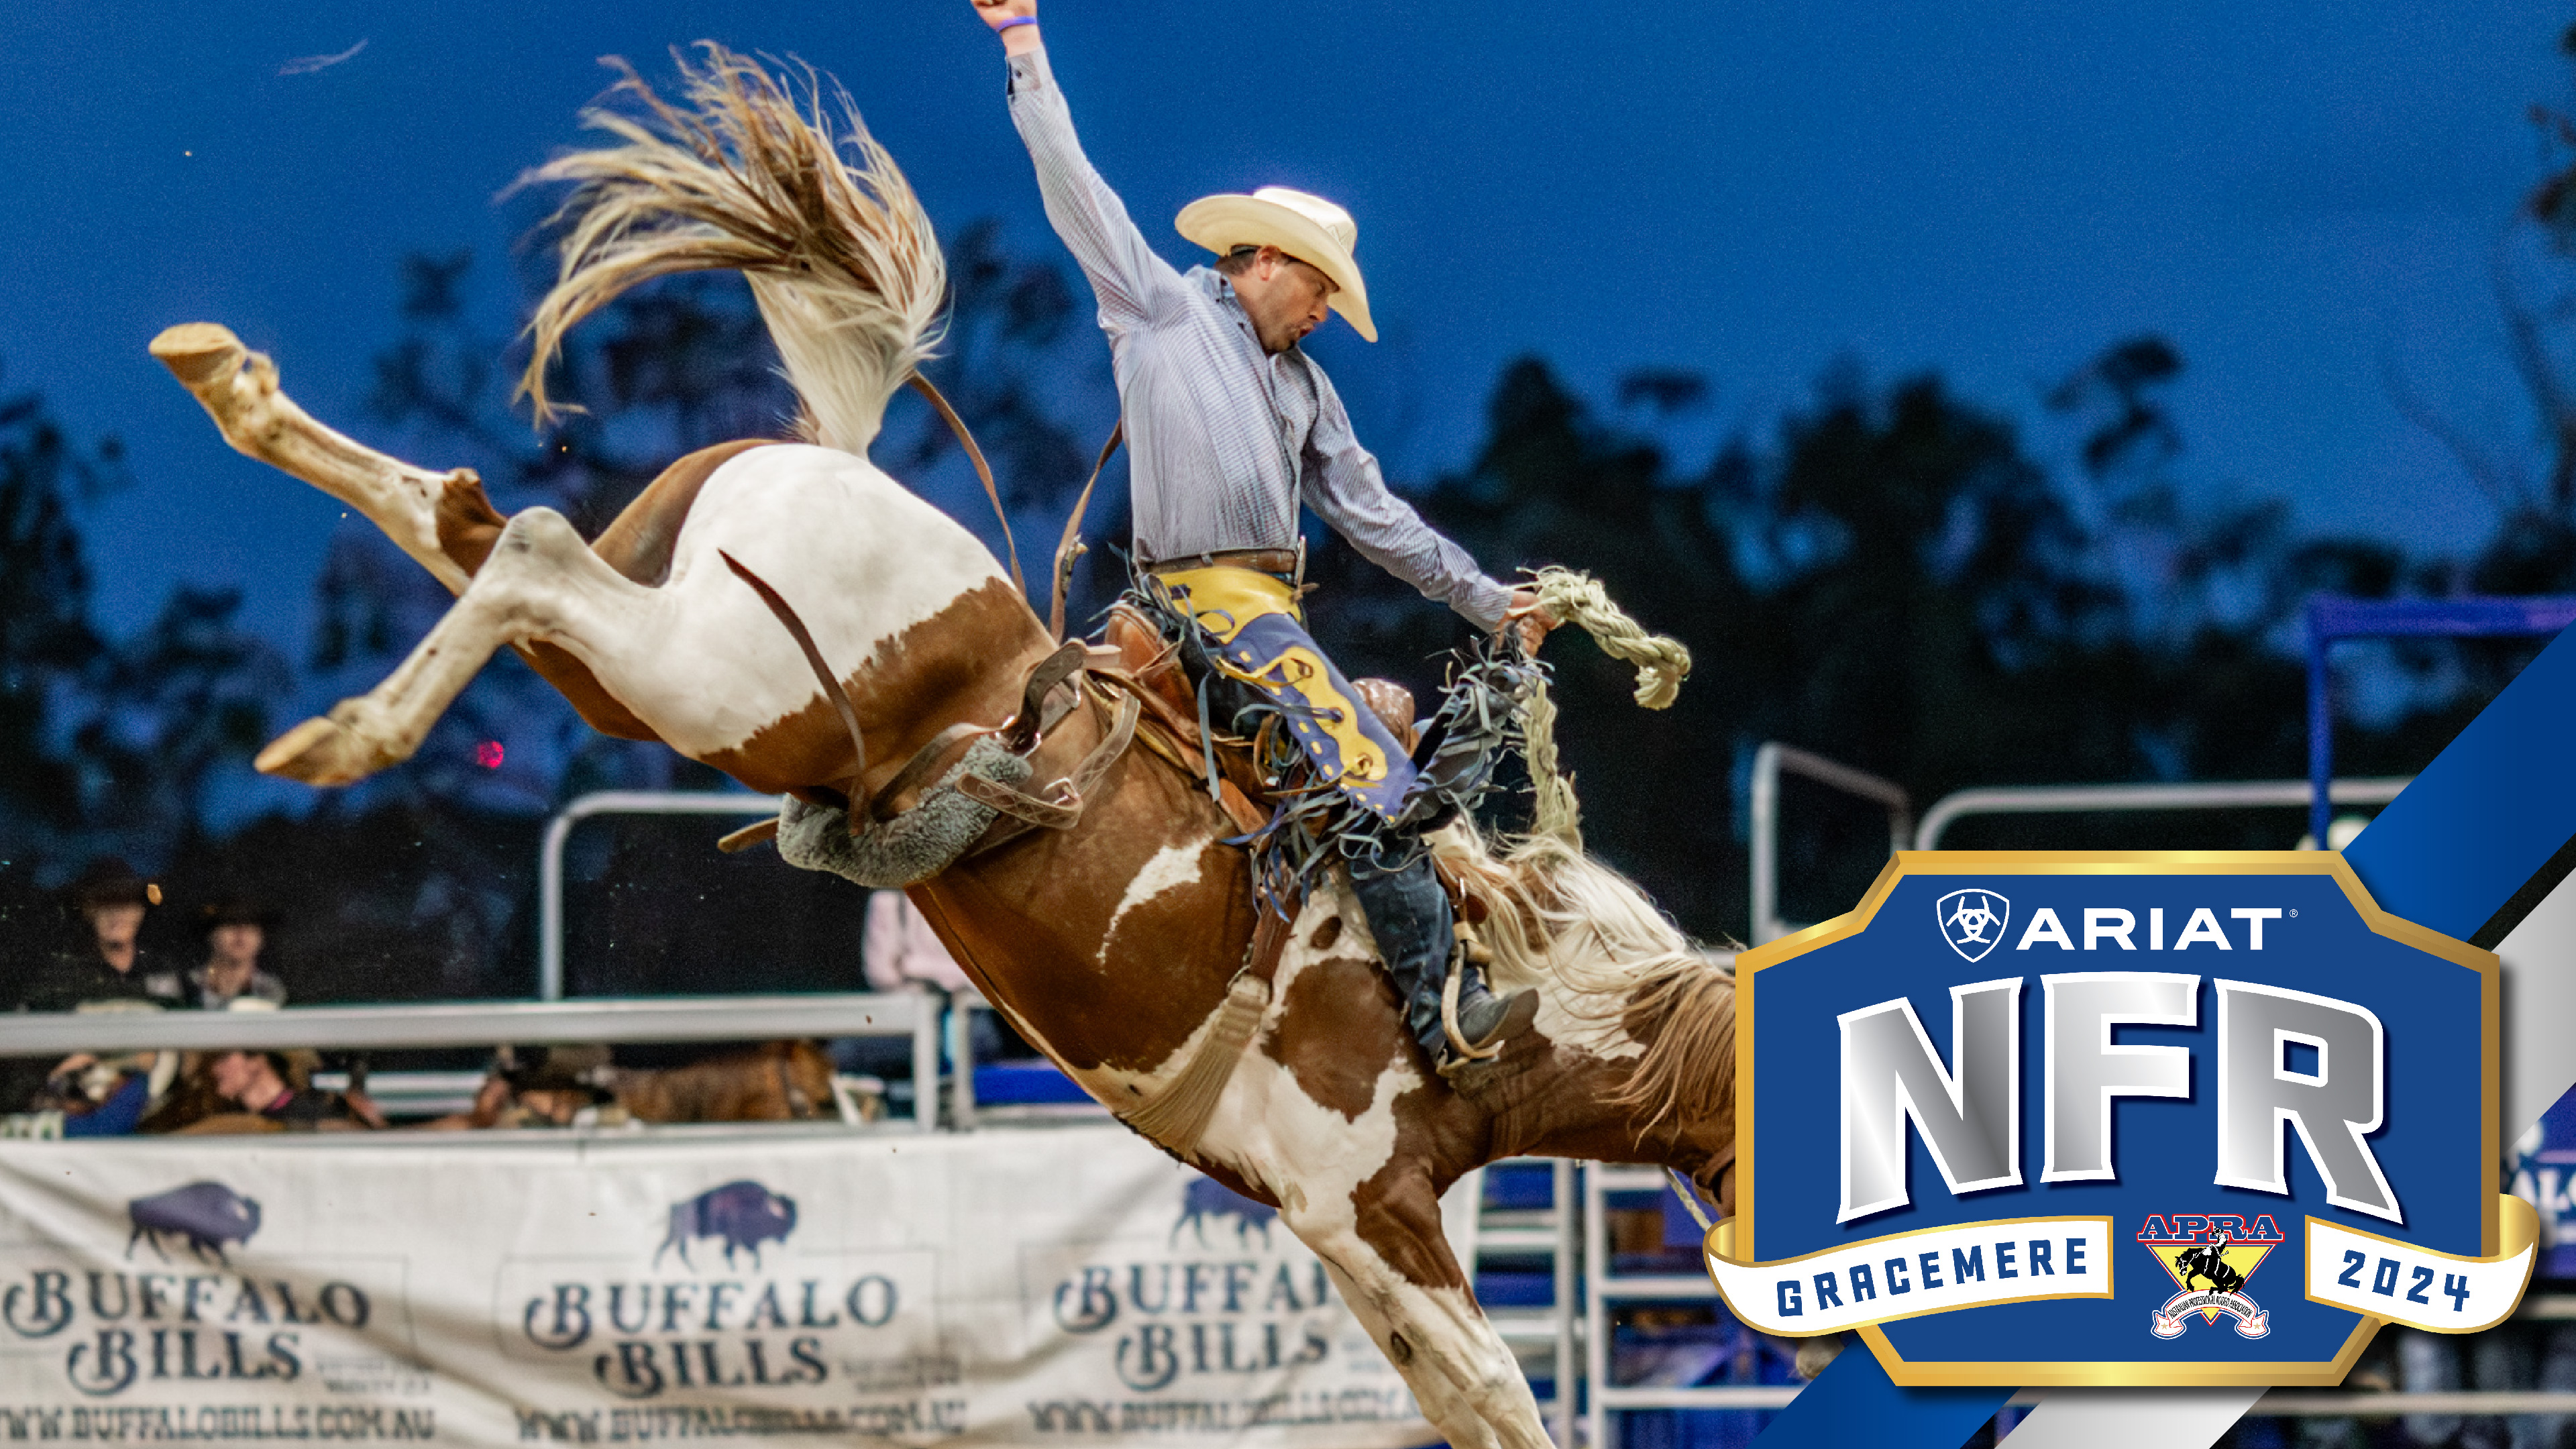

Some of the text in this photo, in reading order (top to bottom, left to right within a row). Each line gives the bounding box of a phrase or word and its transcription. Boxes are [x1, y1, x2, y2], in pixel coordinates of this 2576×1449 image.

[3, 1269, 370, 1339] BUFFALO
[523, 1273, 900, 1351] BUFFALO
[1053, 1260, 1340, 1334] BUFFAL
[66, 1328, 303, 1398] BILLS
[594, 1336, 830, 1400] BILLS
[1115, 1316, 1329, 1392] BILLS
